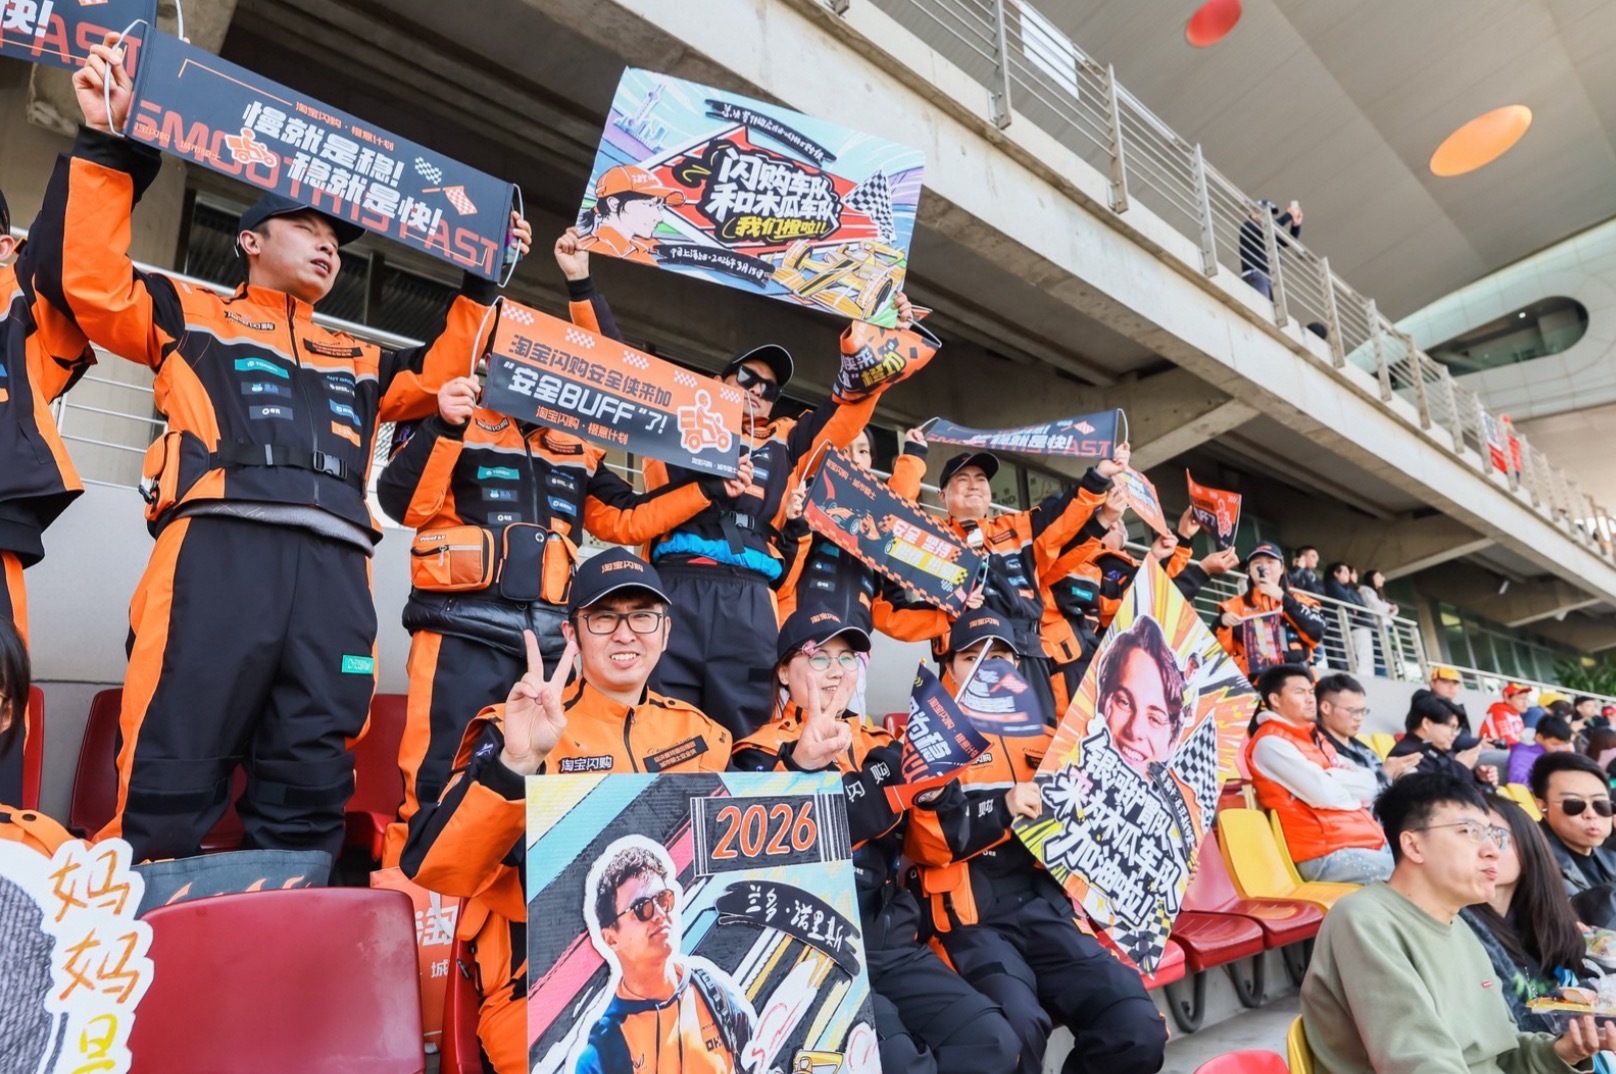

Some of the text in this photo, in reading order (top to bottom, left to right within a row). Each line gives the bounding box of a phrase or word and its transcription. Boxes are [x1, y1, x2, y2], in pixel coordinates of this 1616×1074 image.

[286, 151, 443, 236] 稳就是快!
[718, 147, 832, 202] 闪购车队
[508, 334, 673, 407] 淘宝闪购安全侠来加
[560, 756, 613, 773] 淘宝闪购
[712, 801, 818, 861] 2026
[1046, 819, 1154, 924] 加油啦!
[745, 884, 844, 953] 兰多·诺里斯
